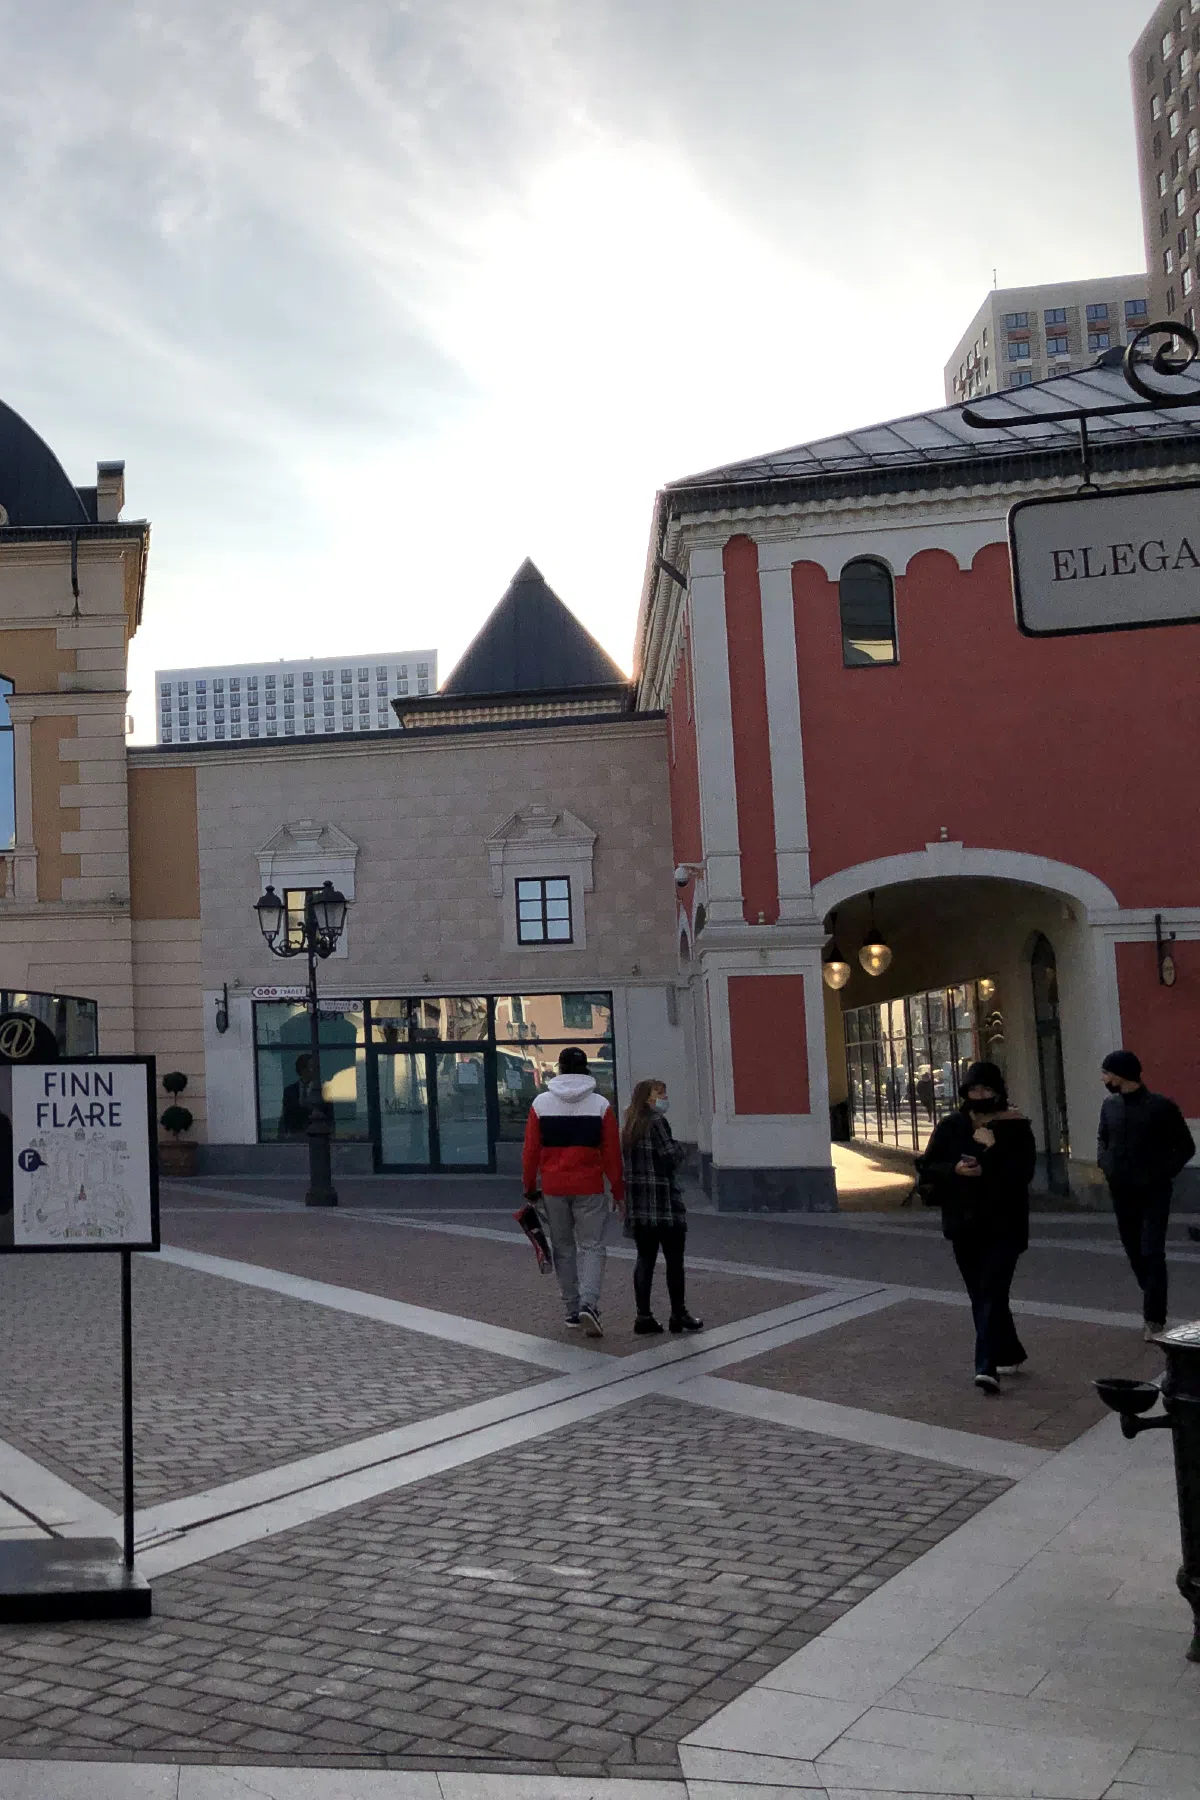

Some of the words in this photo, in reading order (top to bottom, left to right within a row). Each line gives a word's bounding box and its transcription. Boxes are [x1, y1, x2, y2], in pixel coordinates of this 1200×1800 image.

[1050, 537, 1200, 582] ELEGA
[44, 1071, 114, 1097] FINN
[36, 1102, 122, 1128] FLARE
[23, 1151, 36, 1170] F
